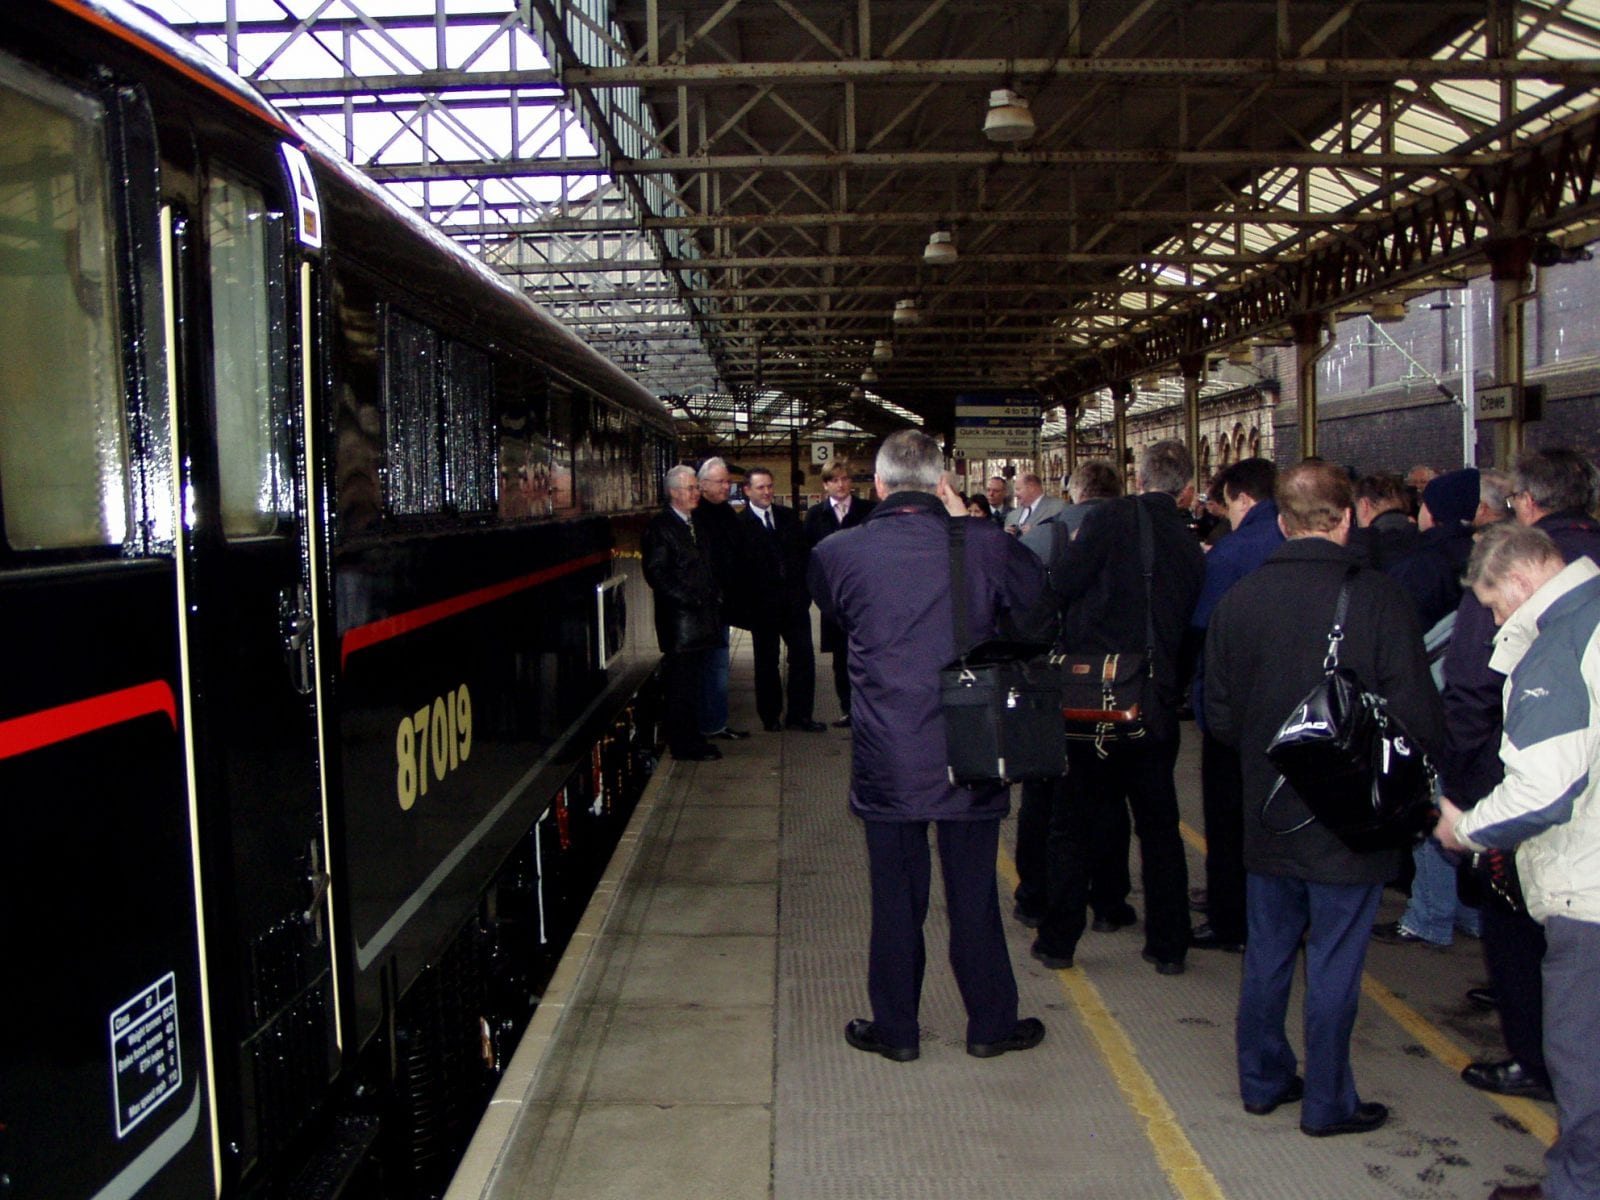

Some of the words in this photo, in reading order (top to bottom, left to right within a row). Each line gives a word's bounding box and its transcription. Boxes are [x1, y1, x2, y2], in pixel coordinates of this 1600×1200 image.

[1480, 395, 1505, 411] Crewe
[817, 445, 828, 460] 3
[1278, 721, 1328, 739] HEAD
[396, 683, 472, 811] 87019
[115, 1013, 130, 1030] Class
